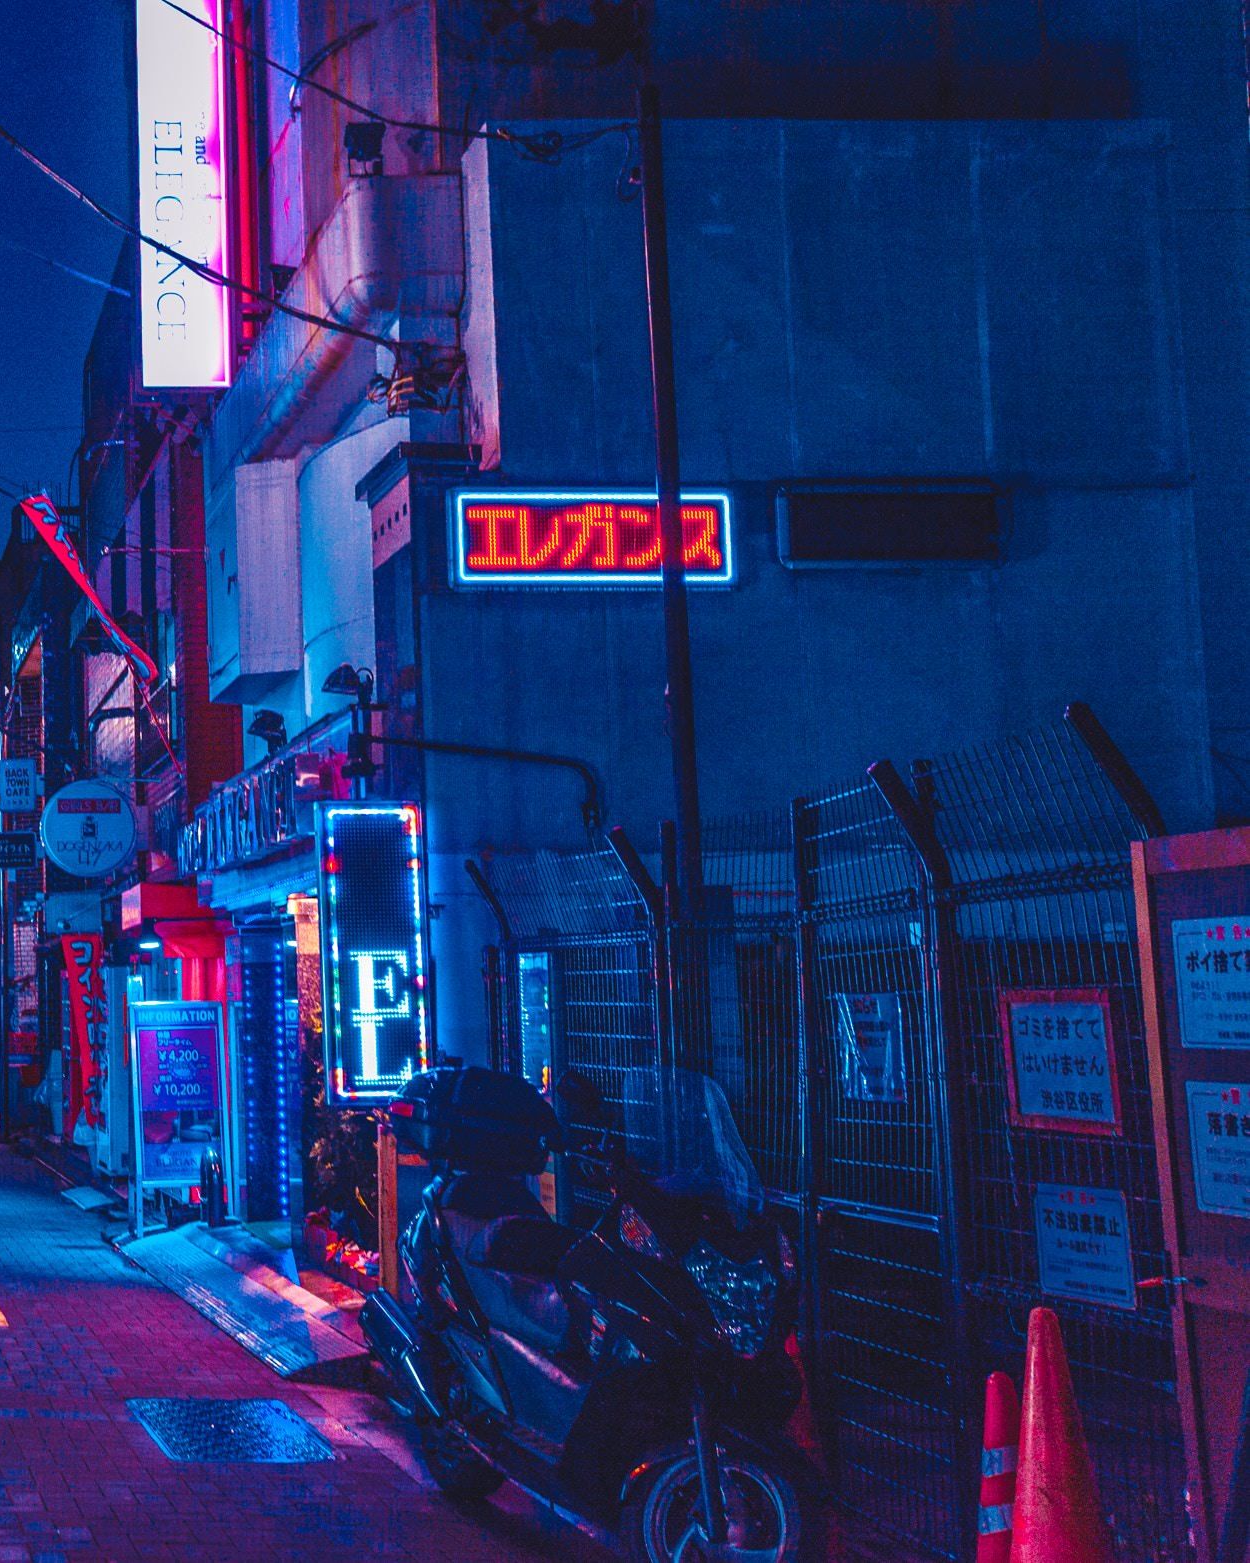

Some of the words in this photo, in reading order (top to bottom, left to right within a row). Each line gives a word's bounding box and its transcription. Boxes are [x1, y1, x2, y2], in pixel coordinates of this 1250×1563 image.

[467, 504, 722, 568] エレガンス
[5, 767, 29, 778] BACK
[6, 778, 30, 788] TOWN
[57, 839, 123, 853] DOGENZAKA
[138, 1009, 216, 1022] INFORMATION
[1017, 1014, 1101, 1041] ゴミを捨てて
[1020, 1050, 1105, 1077] はいけません
[1039, 1087, 1105, 1115] 渋谷区役所
